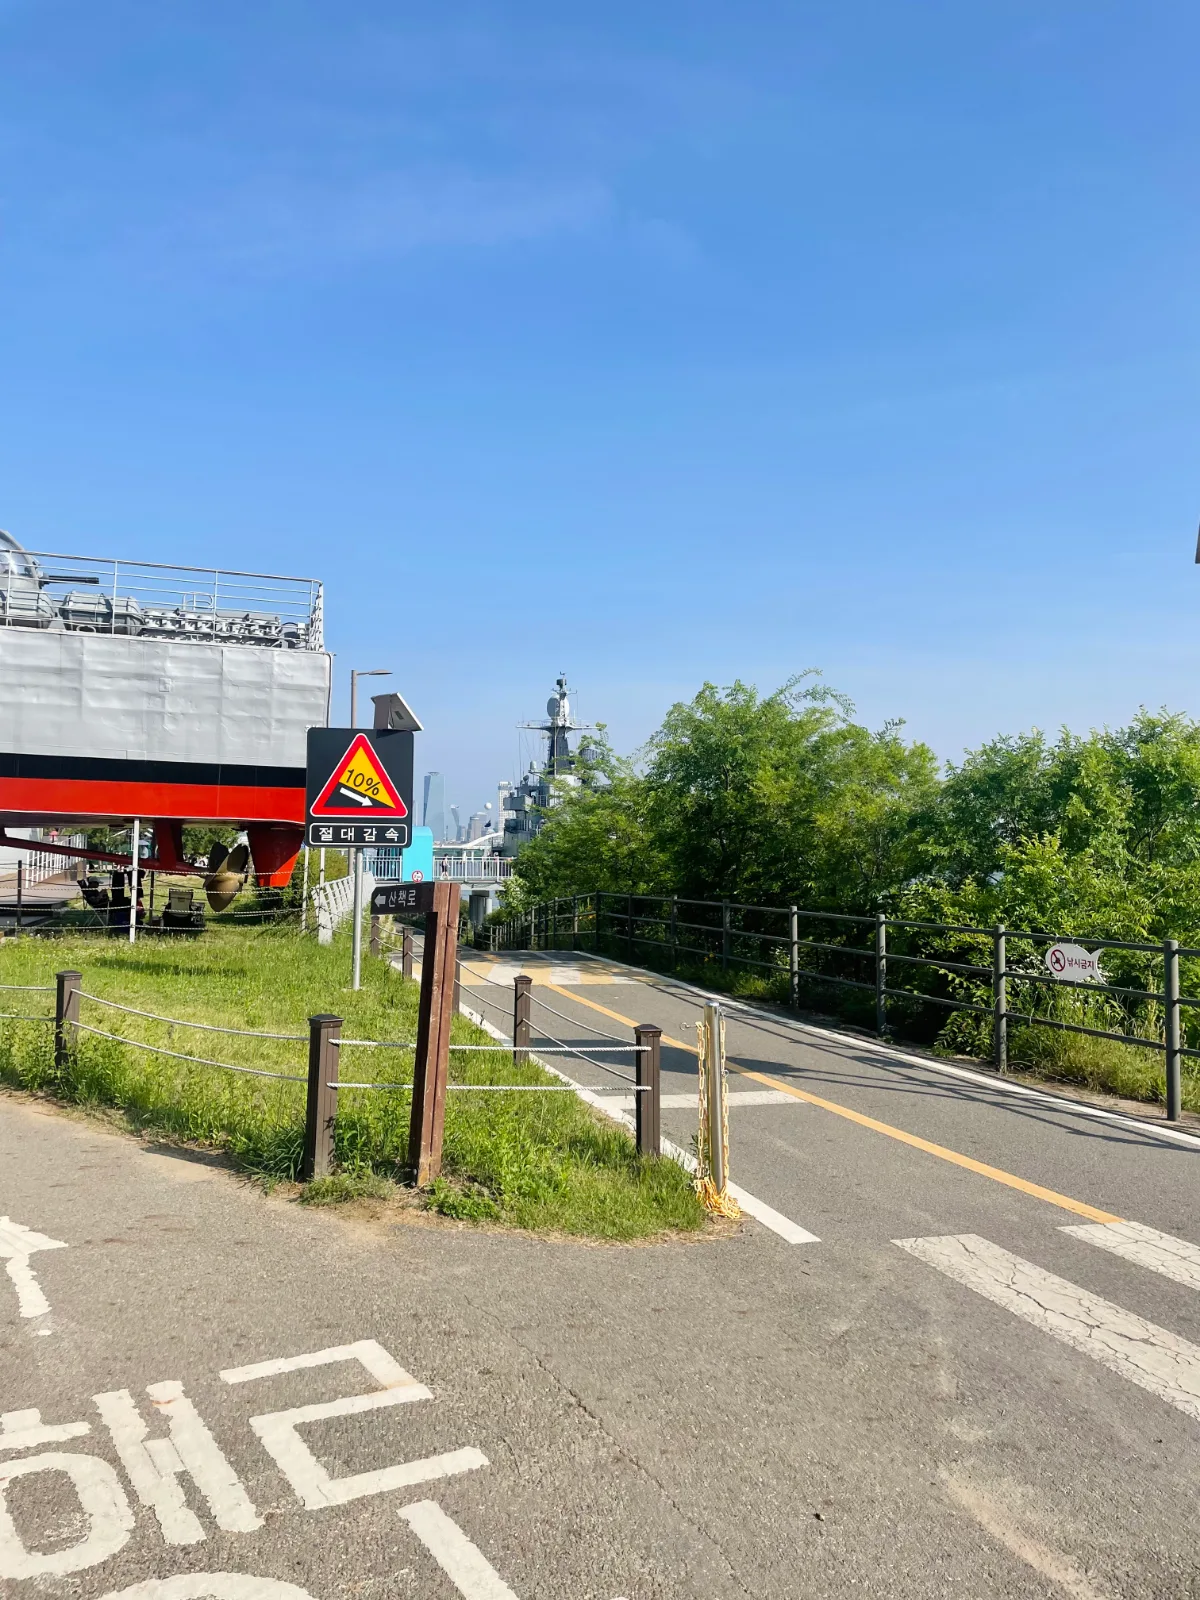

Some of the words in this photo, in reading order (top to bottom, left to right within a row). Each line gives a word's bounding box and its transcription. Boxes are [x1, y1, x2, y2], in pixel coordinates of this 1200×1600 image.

[347, 769, 381, 796] 10%
[388, 889, 416, 908] 산책로
[1067, 957, 1094, 970] 낚시금지
